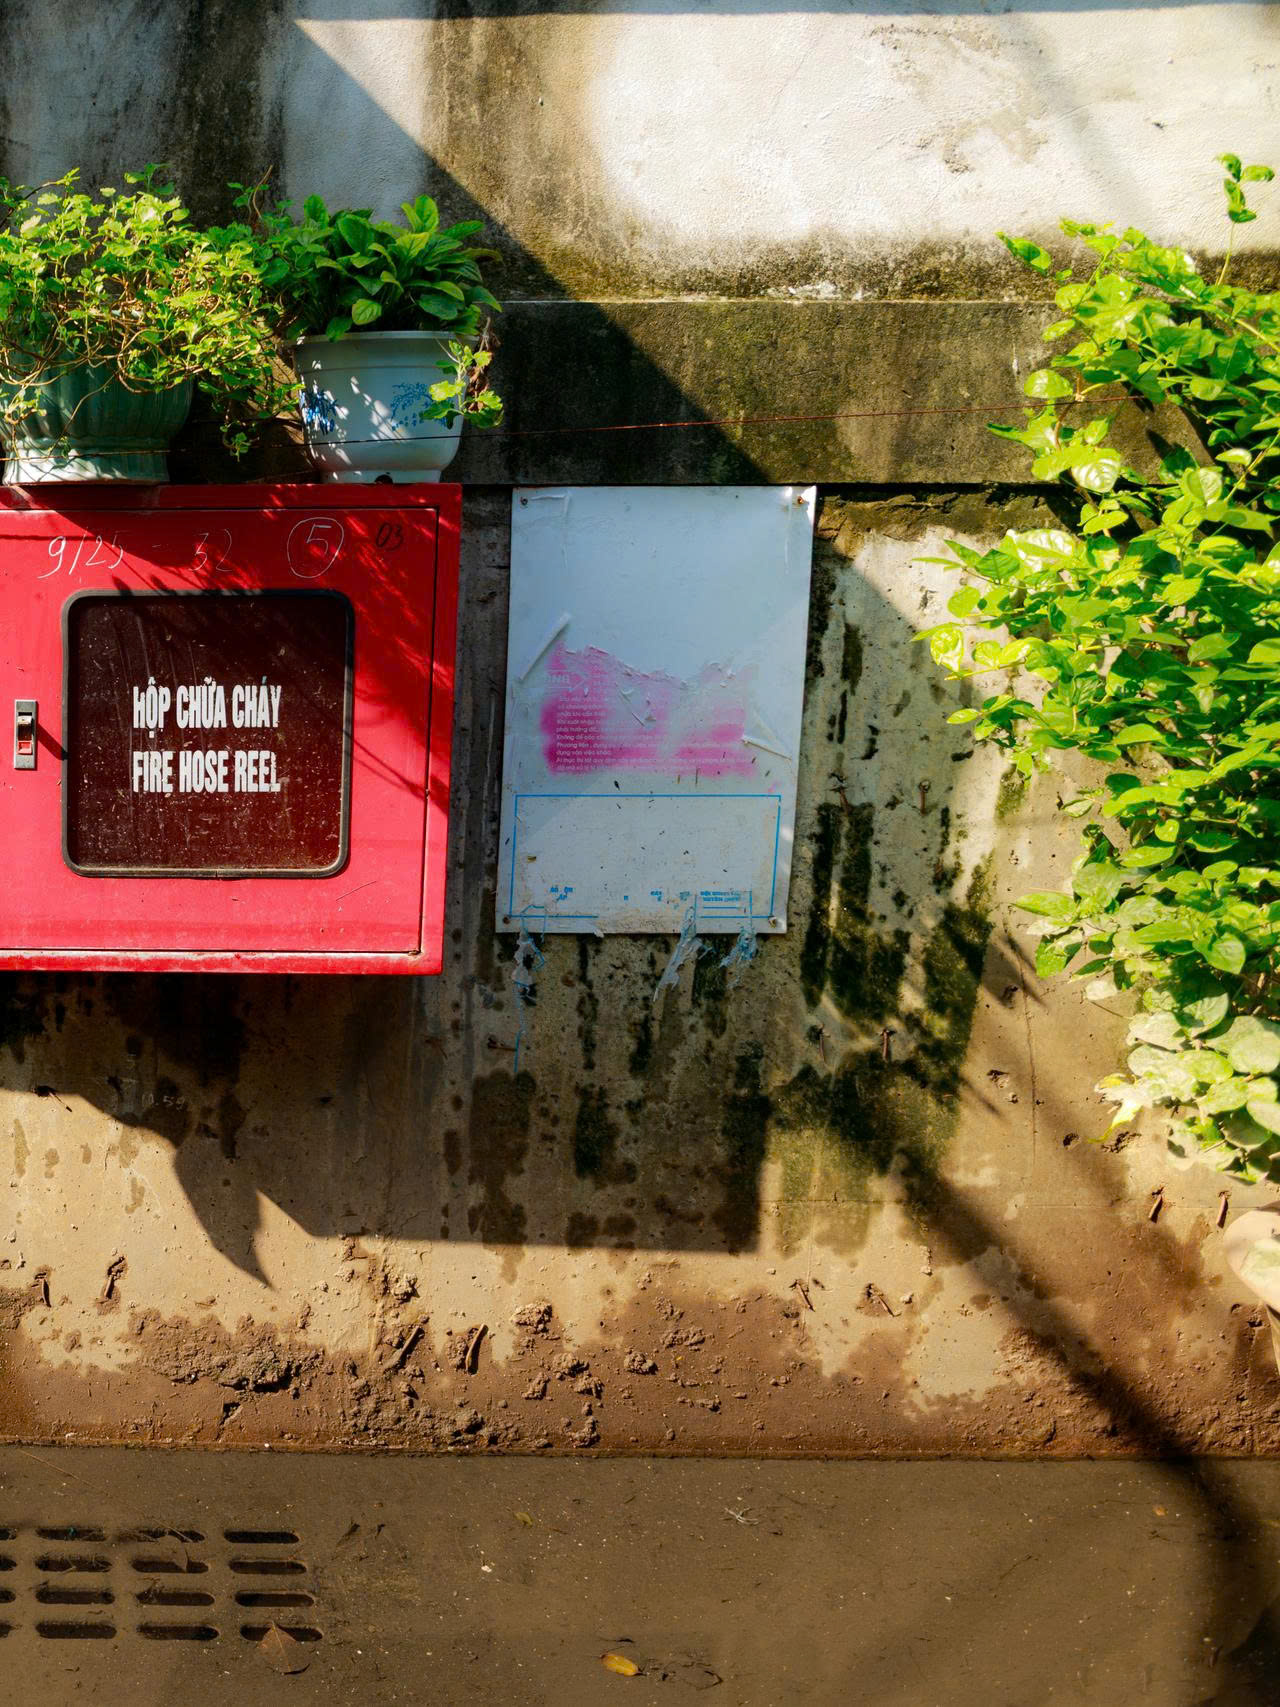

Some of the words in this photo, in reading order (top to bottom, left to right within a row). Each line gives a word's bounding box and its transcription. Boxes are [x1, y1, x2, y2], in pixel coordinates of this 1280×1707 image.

[133, 676, 171, 738] HỘP
[176, 675, 227, 729] CHỮA
[232, 675, 282, 729] CHÁY
[133, 750, 173, 793] FIRE
[179, 750, 229, 793] HOSE
[234, 750, 281, 793] REEL
